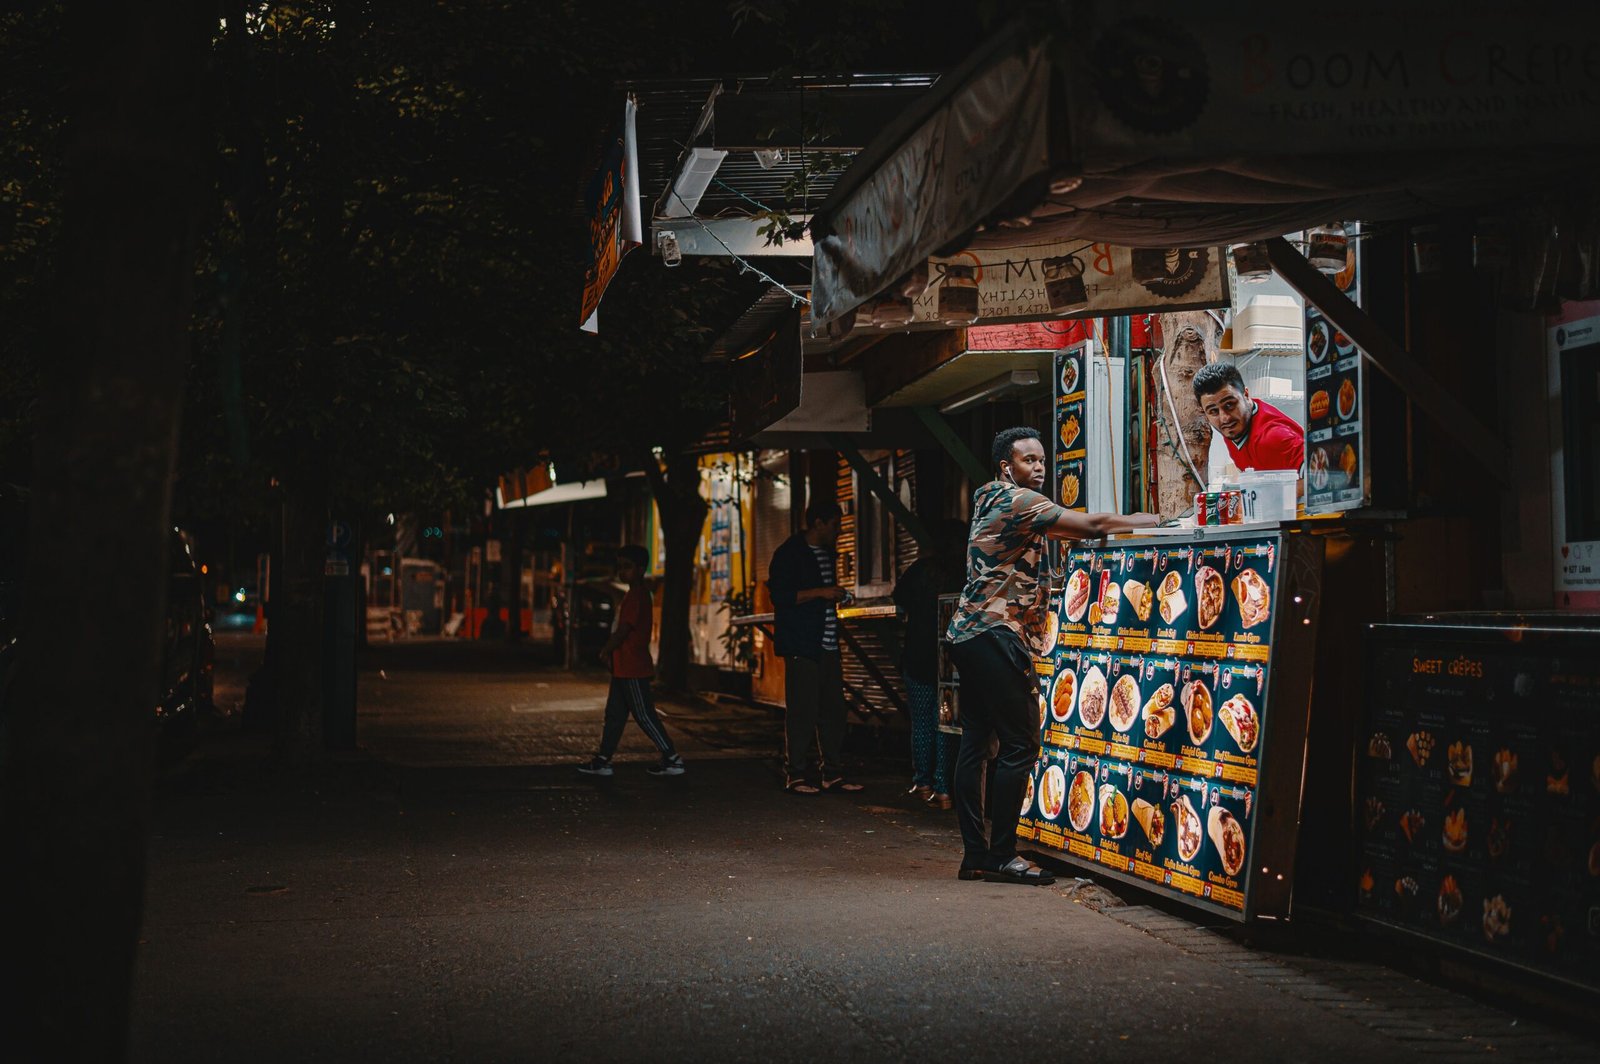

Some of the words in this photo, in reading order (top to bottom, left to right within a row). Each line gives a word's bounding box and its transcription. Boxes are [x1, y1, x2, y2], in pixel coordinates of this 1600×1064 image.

[1241, 31, 1410, 95] BOOM
[1412, 657, 1443, 674] SWEET
[1447, 655, 1484, 678] CRÊPES
